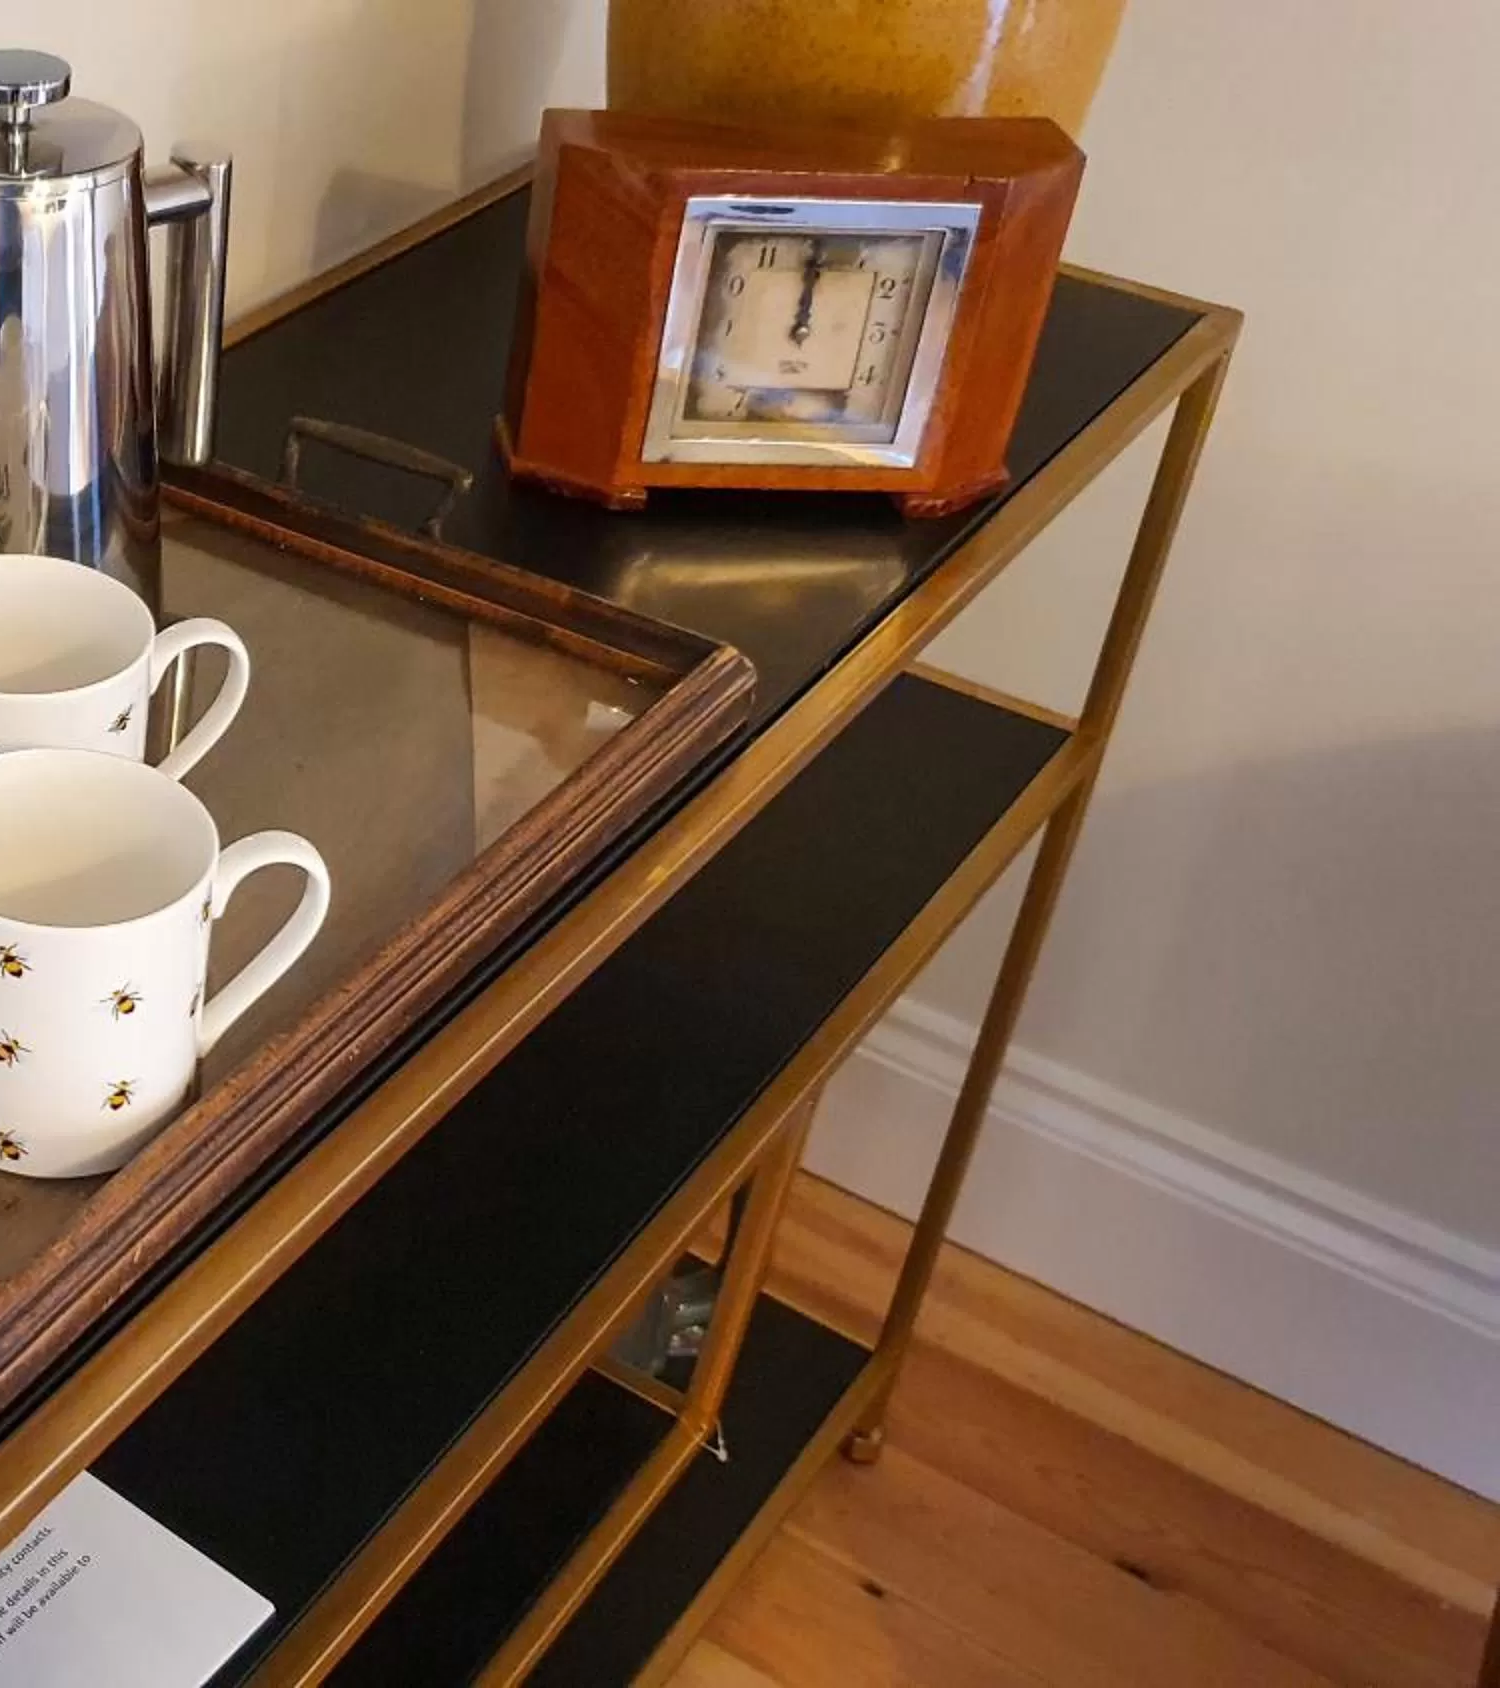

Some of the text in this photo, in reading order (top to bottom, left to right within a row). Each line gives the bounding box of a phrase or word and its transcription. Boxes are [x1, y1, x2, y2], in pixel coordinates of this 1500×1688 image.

[5, 1576, 40, 1607] details
[36, 1566, 51, 1578] in
[47, 1547, 69, 1567] this
[6, 1615, 26, 1636] will
[21, 1604, 40, 1619] be
[39, 1565, 81, 1607] available
[76, 1554, 92, 1567] to
